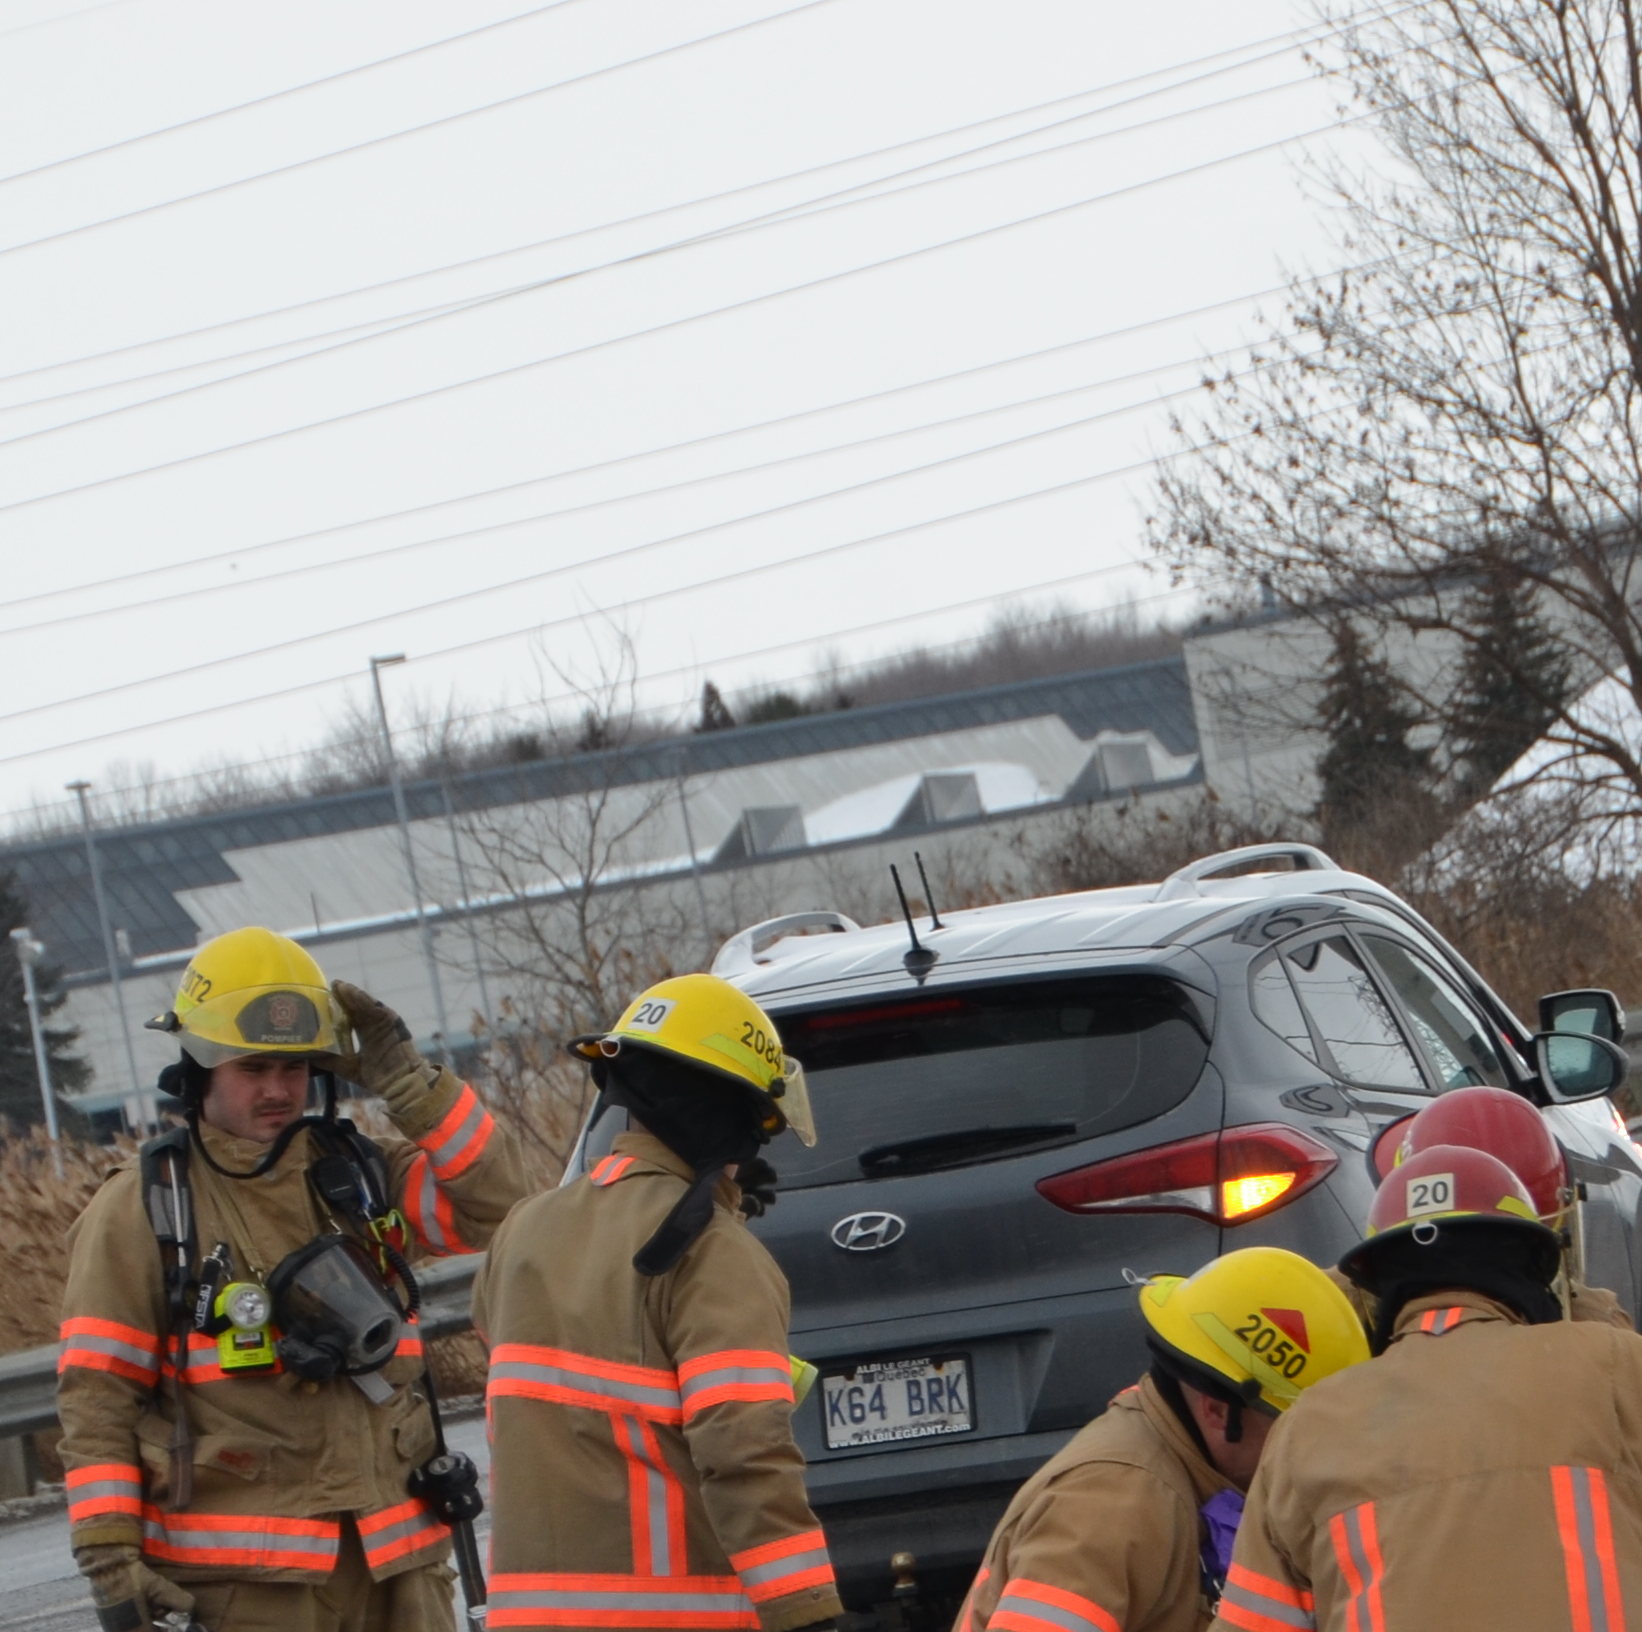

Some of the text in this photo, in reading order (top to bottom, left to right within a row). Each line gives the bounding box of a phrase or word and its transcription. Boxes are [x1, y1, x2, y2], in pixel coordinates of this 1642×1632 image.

[181, 965, 213, 1004] 072
[631, 1002, 667, 1025] 20
[740, 1021, 783, 1073] 2084
[1412, 1180, 1449, 1209] 20
[1234, 1313, 1307, 1379] 2050
[856, 1362, 882, 1374] ALBI
[883, 1361, 895, 1371] LE
[826, 1373, 965, 1428] K64 BRK
